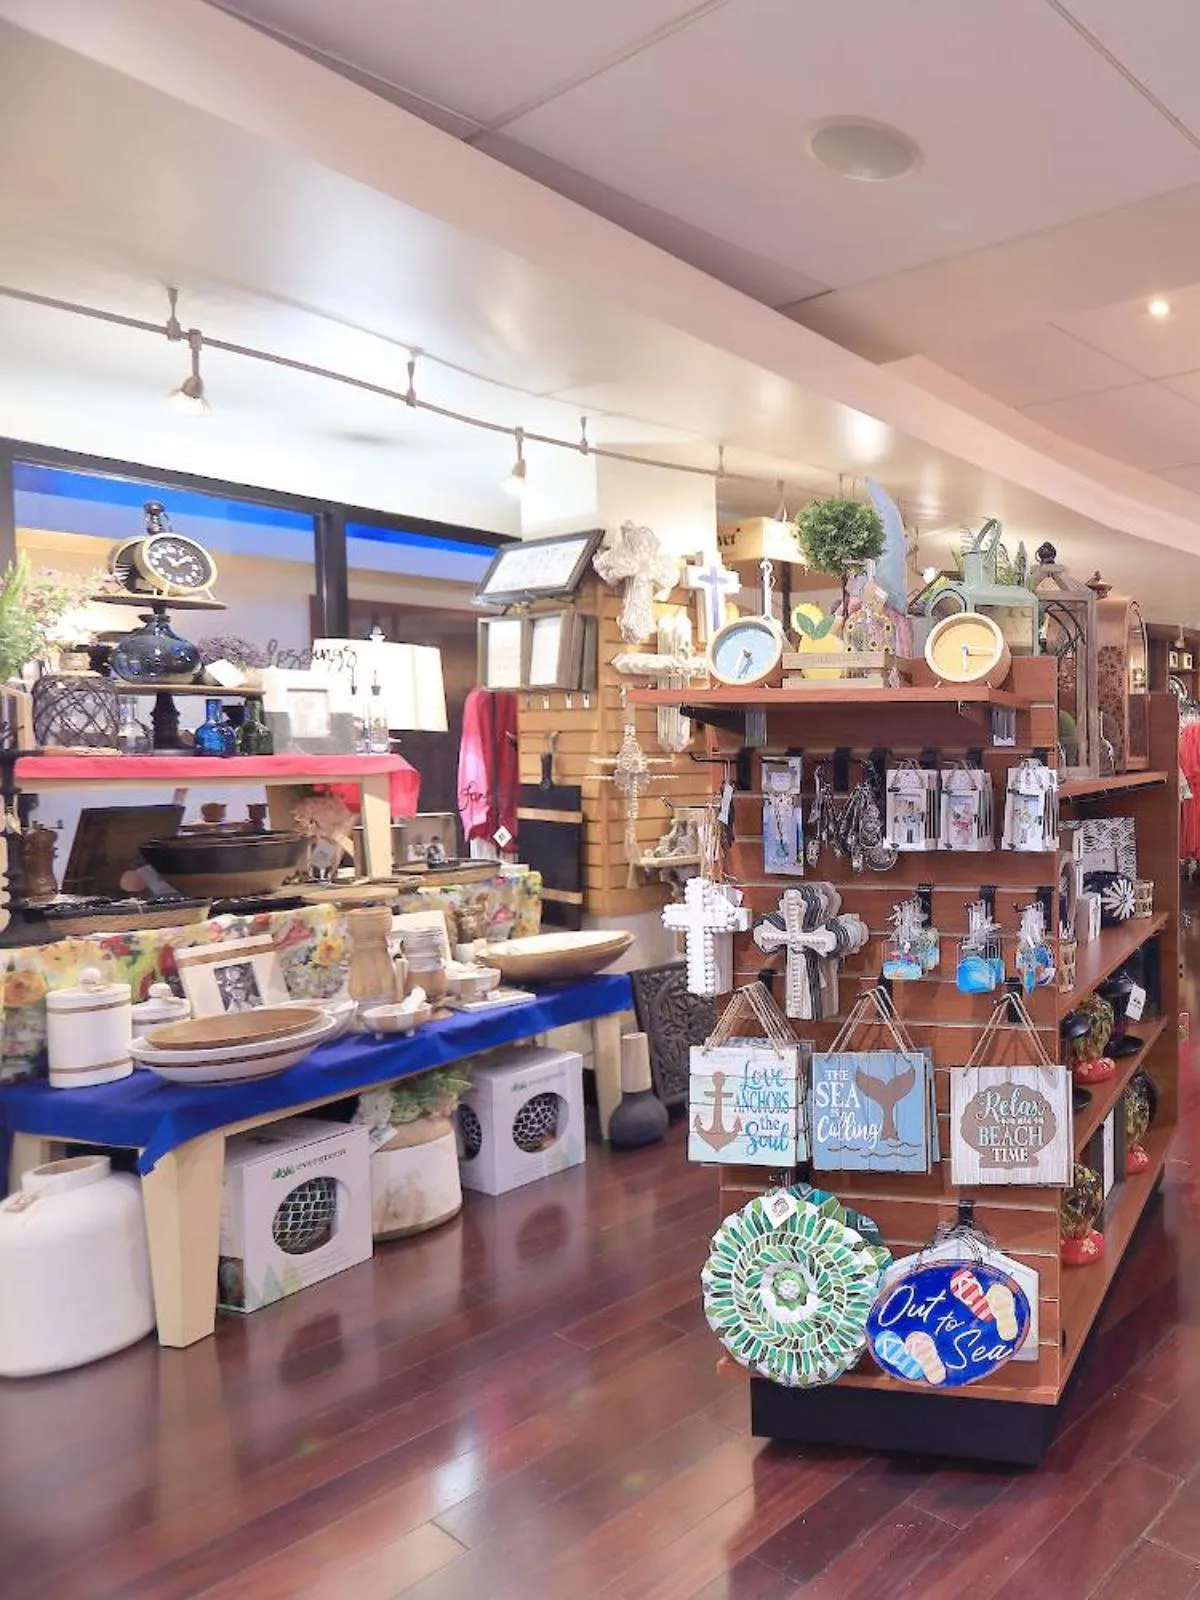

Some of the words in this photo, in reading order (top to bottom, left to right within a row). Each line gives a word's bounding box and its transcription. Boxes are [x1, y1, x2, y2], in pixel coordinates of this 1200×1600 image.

[740, 1060, 788, 1091] Love
[825, 1069, 849, 1081] THE
[815, 1081, 860, 1109] SEA
[760, 1114, 780, 1130] the
[817, 1111, 882, 1150] Calling
[745, 1121, 790, 1156] Soul
[978, 1126, 1044, 1147] BEACH
[991, 1147, 1029, 1162] TIME
[878, 1284, 947, 1328] Out
[935, 1311, 966, 1337] to
[945, 1329, 1014, 1370] Sea
